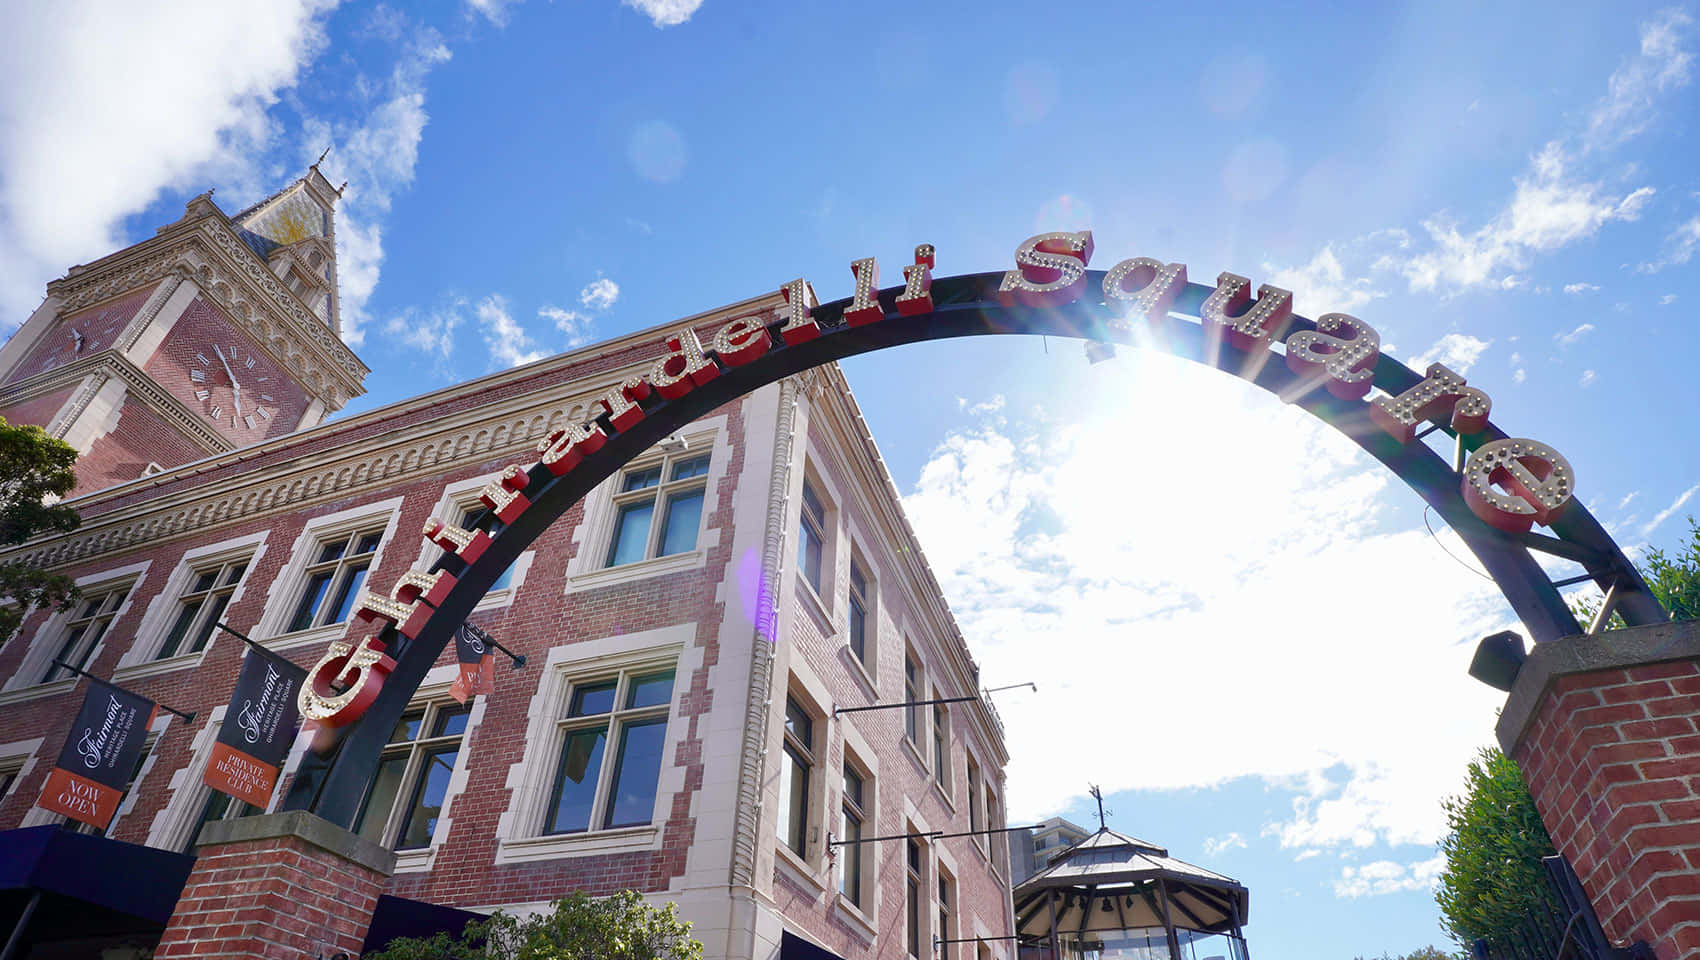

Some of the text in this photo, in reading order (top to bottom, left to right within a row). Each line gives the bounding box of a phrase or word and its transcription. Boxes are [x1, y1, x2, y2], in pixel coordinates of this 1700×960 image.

[297, 230, 1576, 728] Ghirardelli Square
[126, 708, 138, 730] SQUARE
[237, 663, 281, 744] Fairmont
[262, 682, 285, 733] HERITAGE PLACE
[266, 679, 294, 744] GHIRARDELLI SQUARE
[77, 693, 123, 769] Fairmont
[103, 711, 128, 759] HERITAGE PLACE
[216, 759, 269, 791] RESIDENCE
[227, 754, 265, 777] PRIVATE
[227, 777, 254, 793] CLUB
[58, 792, 97, 816] OPEN
[70, 780, 102, 801] NOW
